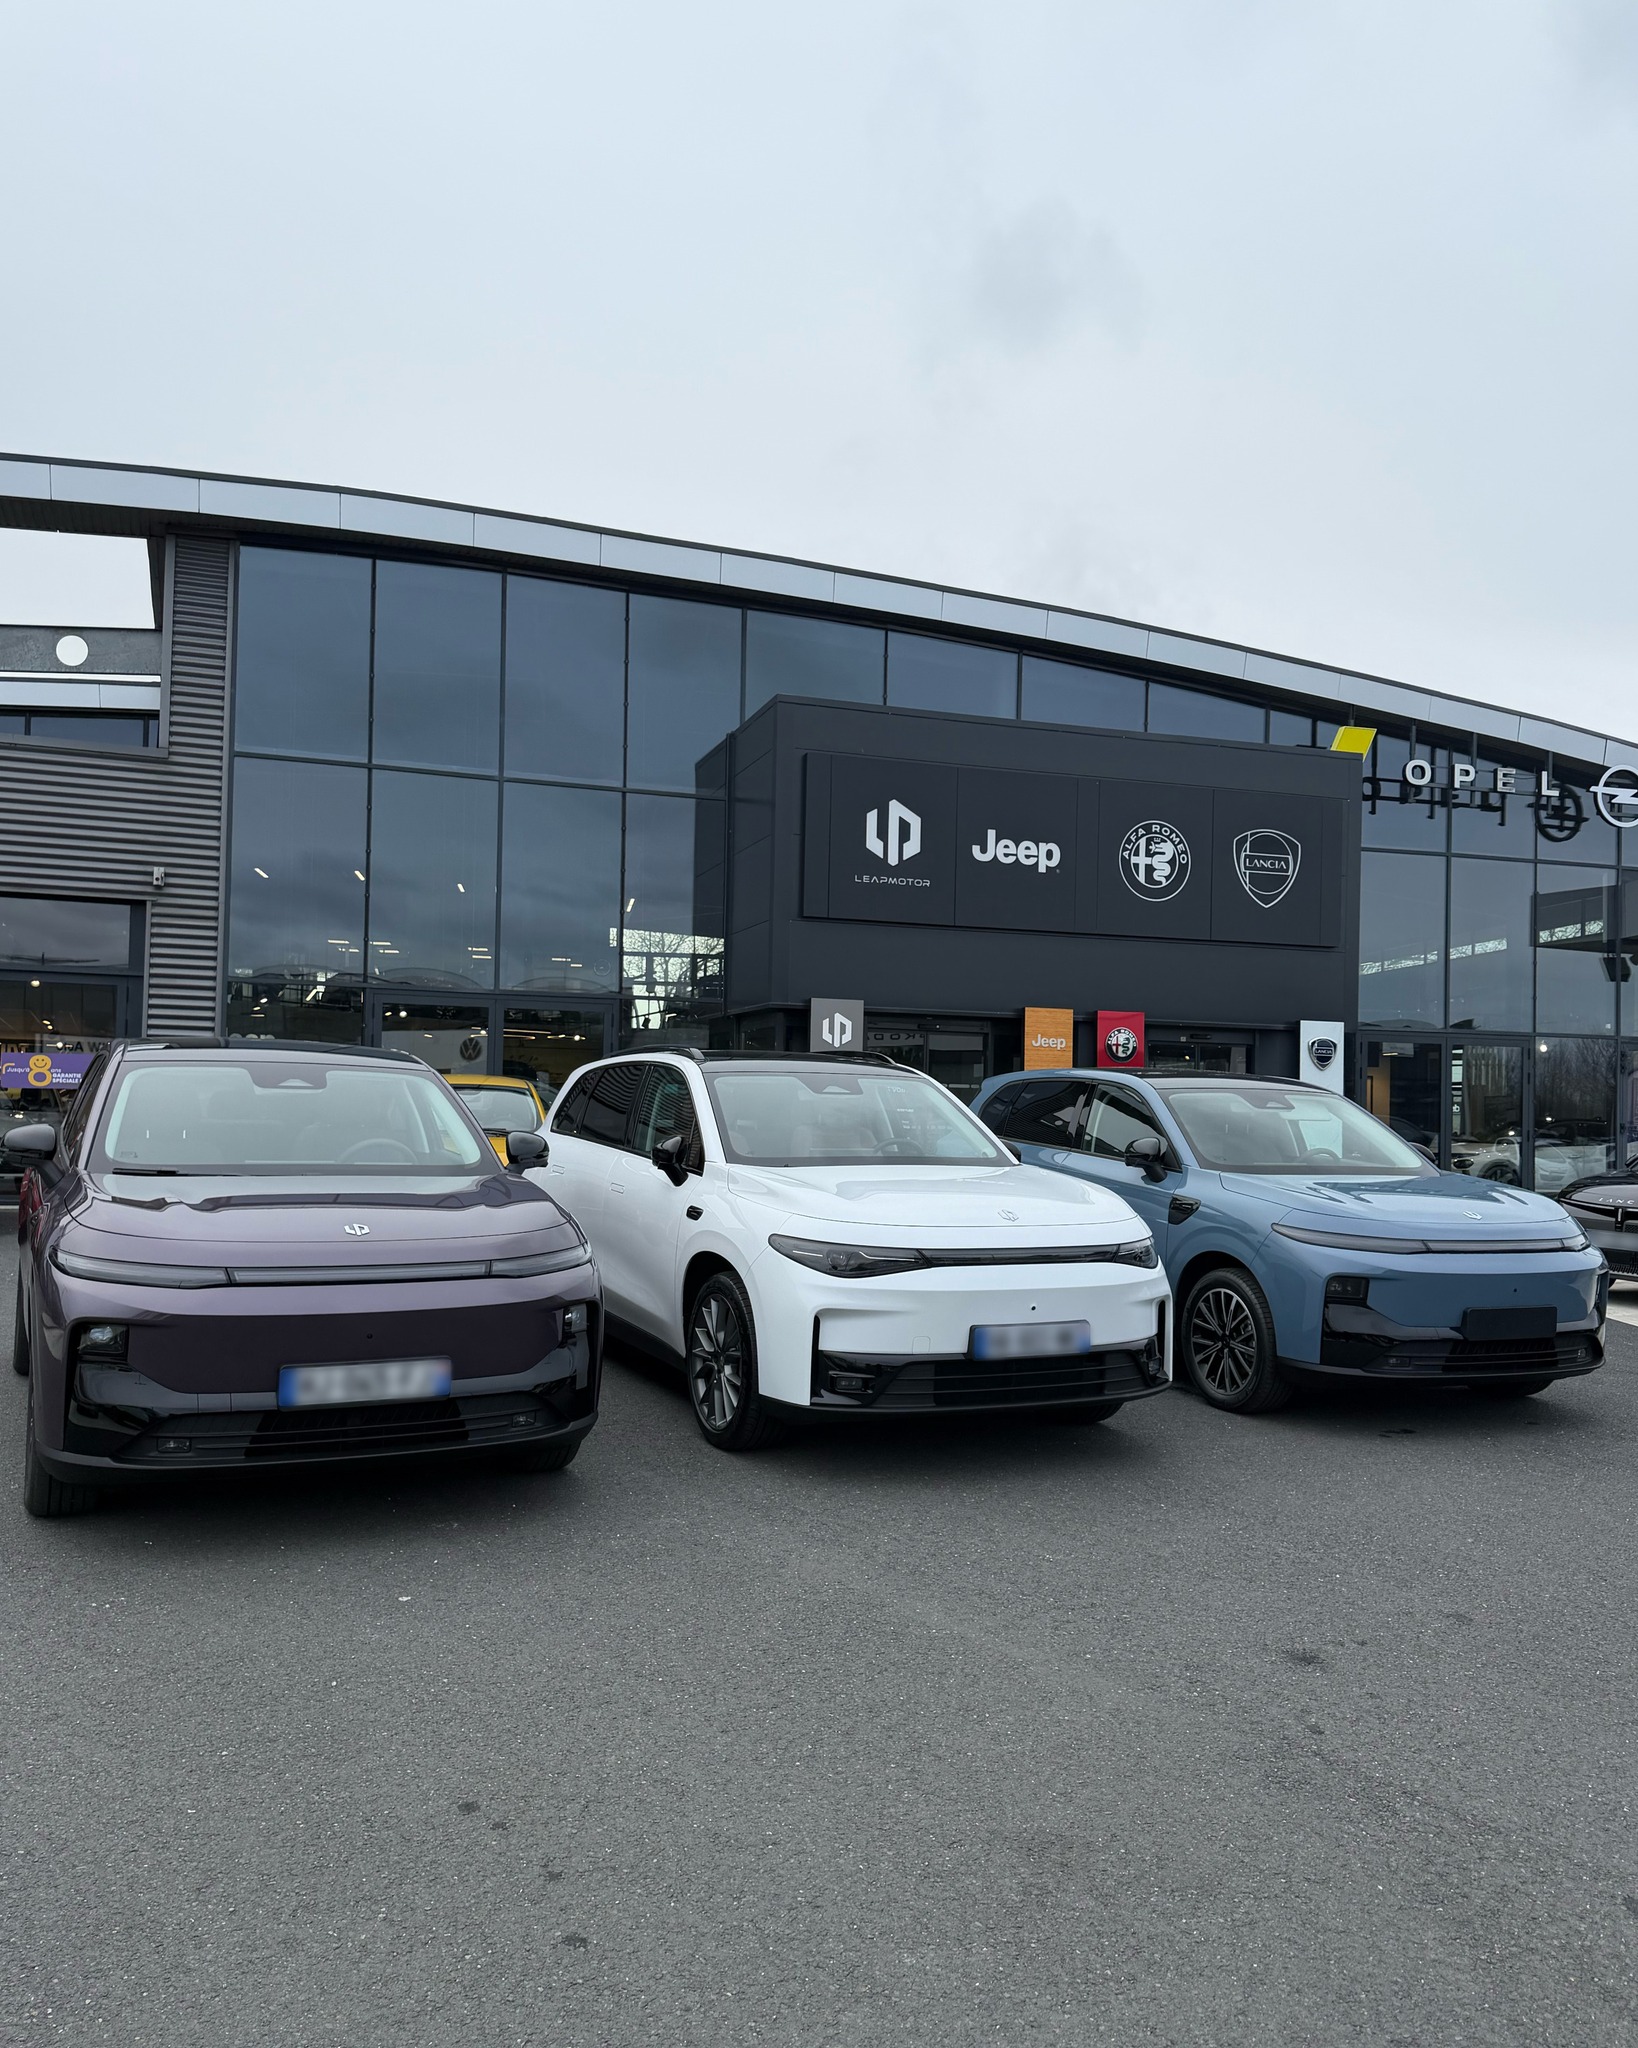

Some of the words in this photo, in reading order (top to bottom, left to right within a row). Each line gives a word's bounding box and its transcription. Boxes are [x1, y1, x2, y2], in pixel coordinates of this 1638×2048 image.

[1403, 758, 1560, 797] OPEL
[971, 828, 1061, 873] Jeep
[1122, 827, 1147, 860] ALFA
[1151, 824, 1188, 864] ROMEO
[1246, 858, 1287, 870] LANCIA
[854, 874, 931, 888] LEAPMOTOR
[1031, 1033, 1067, 1050] Jeep
